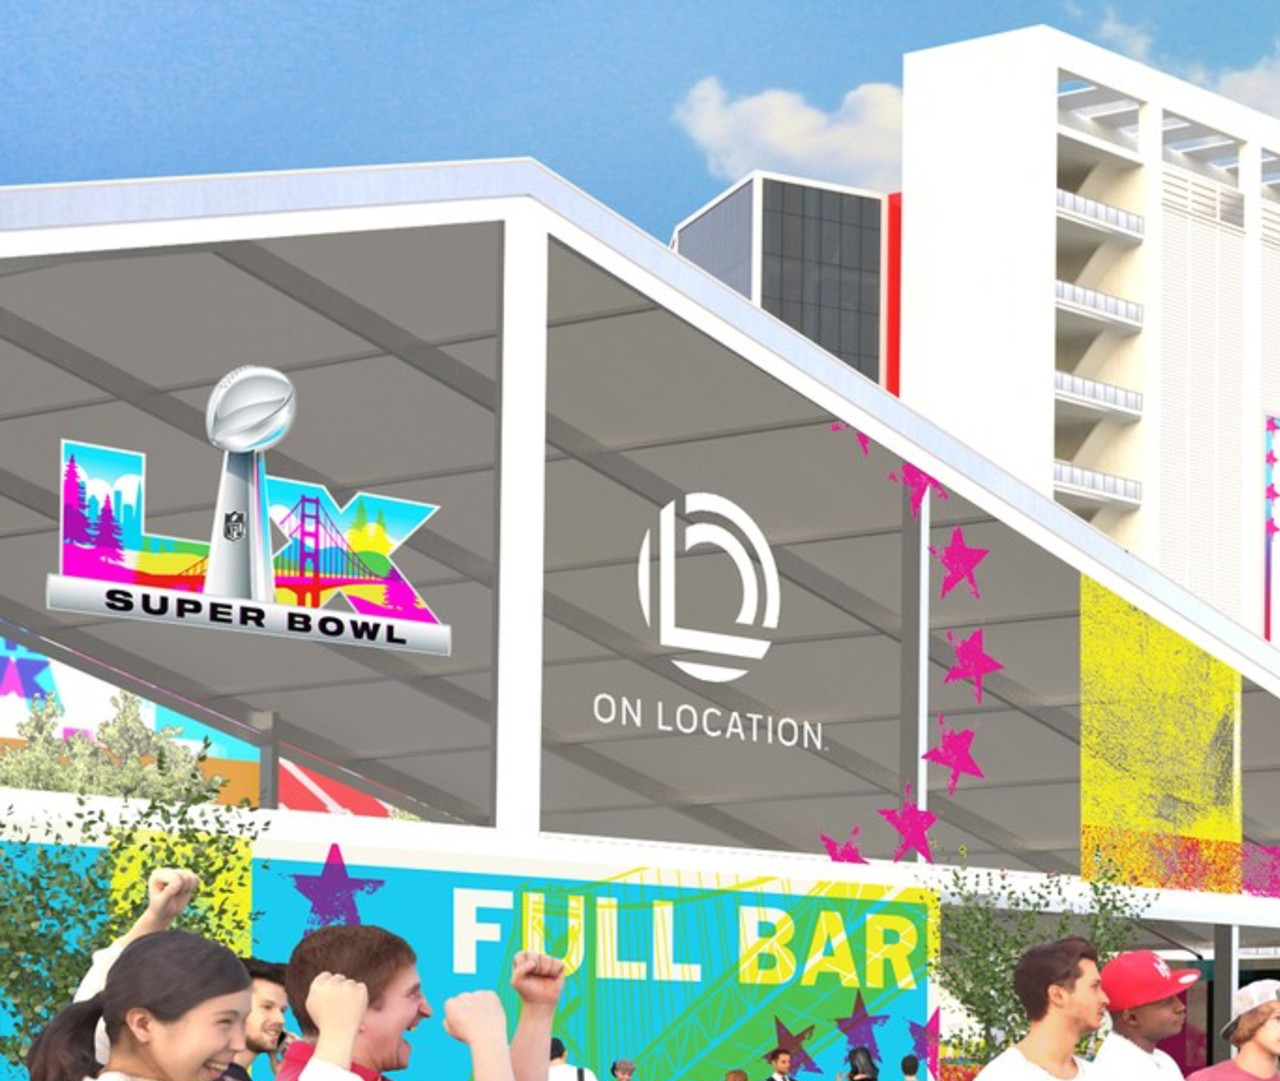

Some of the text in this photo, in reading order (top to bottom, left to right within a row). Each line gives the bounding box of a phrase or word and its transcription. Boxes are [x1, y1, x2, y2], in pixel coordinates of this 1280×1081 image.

[105, 589, 407, 645] SUPER BOWL
[593, 692, 823, 751] ON LOCATION
[452, 886, 918, 990] FULL BAR
